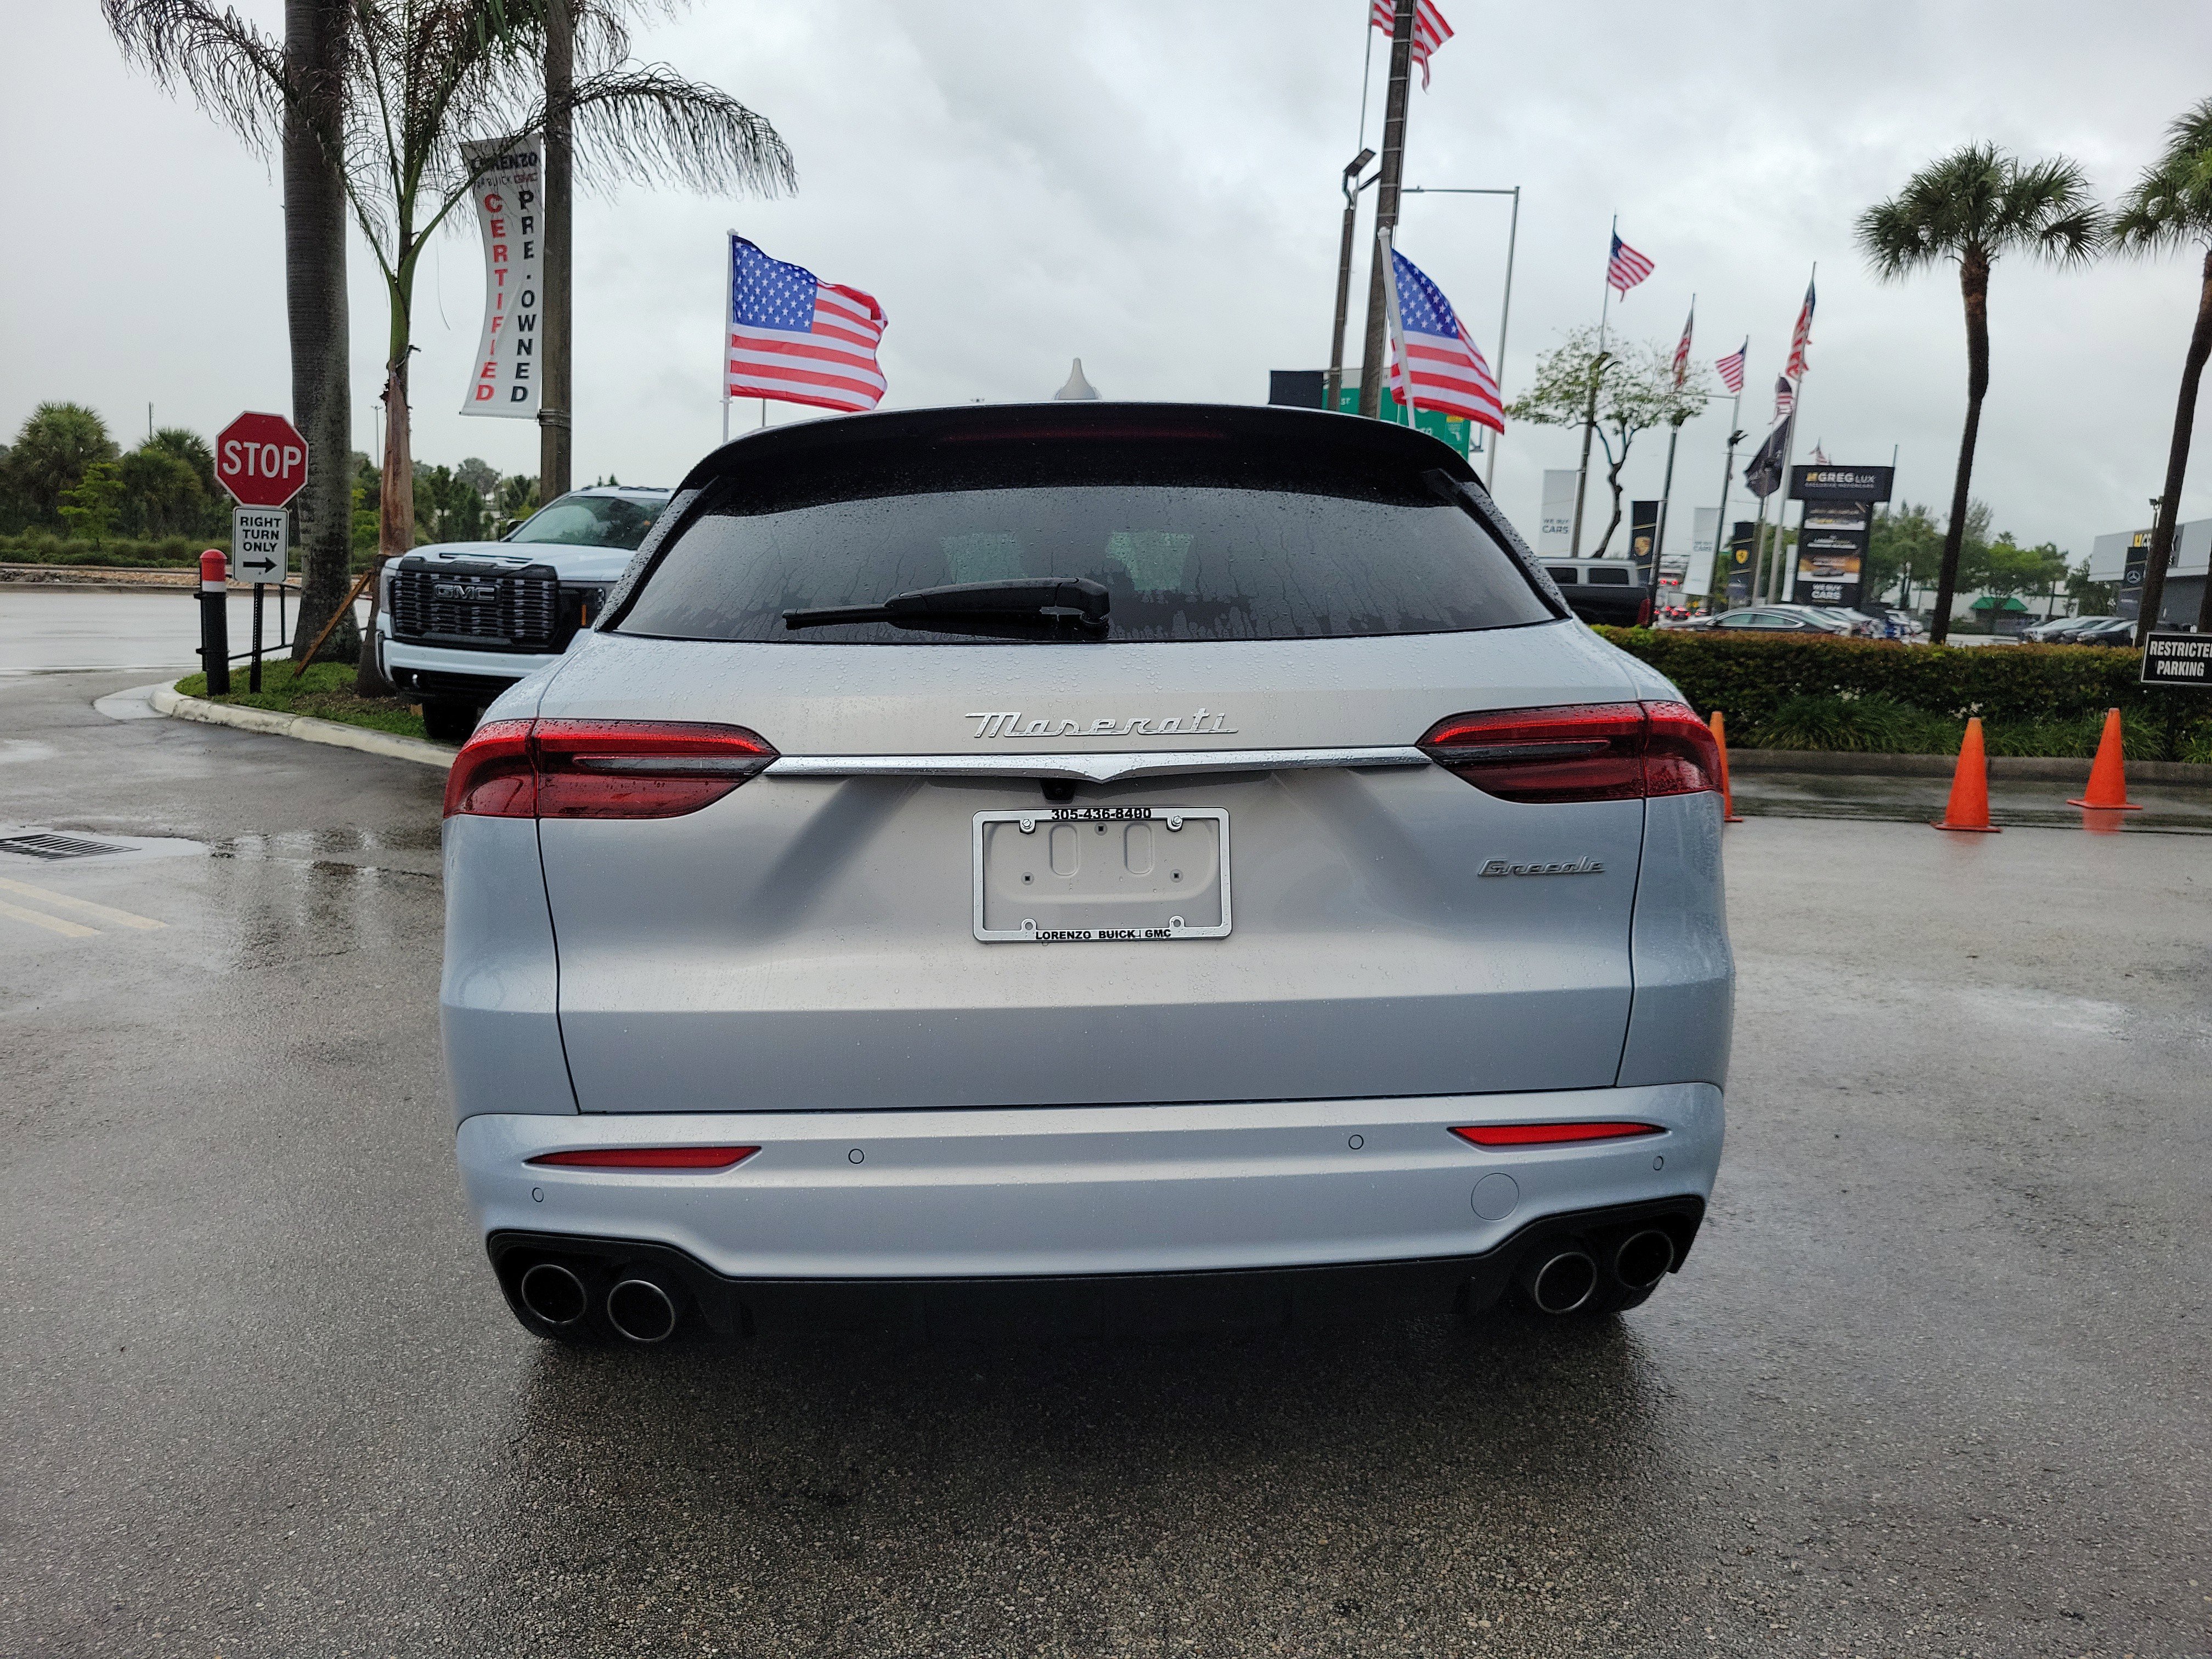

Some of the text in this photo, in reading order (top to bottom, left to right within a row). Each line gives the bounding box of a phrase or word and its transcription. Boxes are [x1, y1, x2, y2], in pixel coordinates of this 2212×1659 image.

[476, 194, 509, 402] CERTIFIED
[222, 439, 302, 479] STOP
[240, 516, 282, 528] RIGHT
[242, 529, 280, 540] TURN
[243, 541, 278, 552] ONLY
[436, 584, 495, 601] GMC
[2156, 661, 2204, 677] PARKING
[964, 708, 1239, 738] Maserati
[1051, 808, 1152, 820] 305-436-8400
[1035, 929, 1171, 940] LORENZO BUICK GMC
